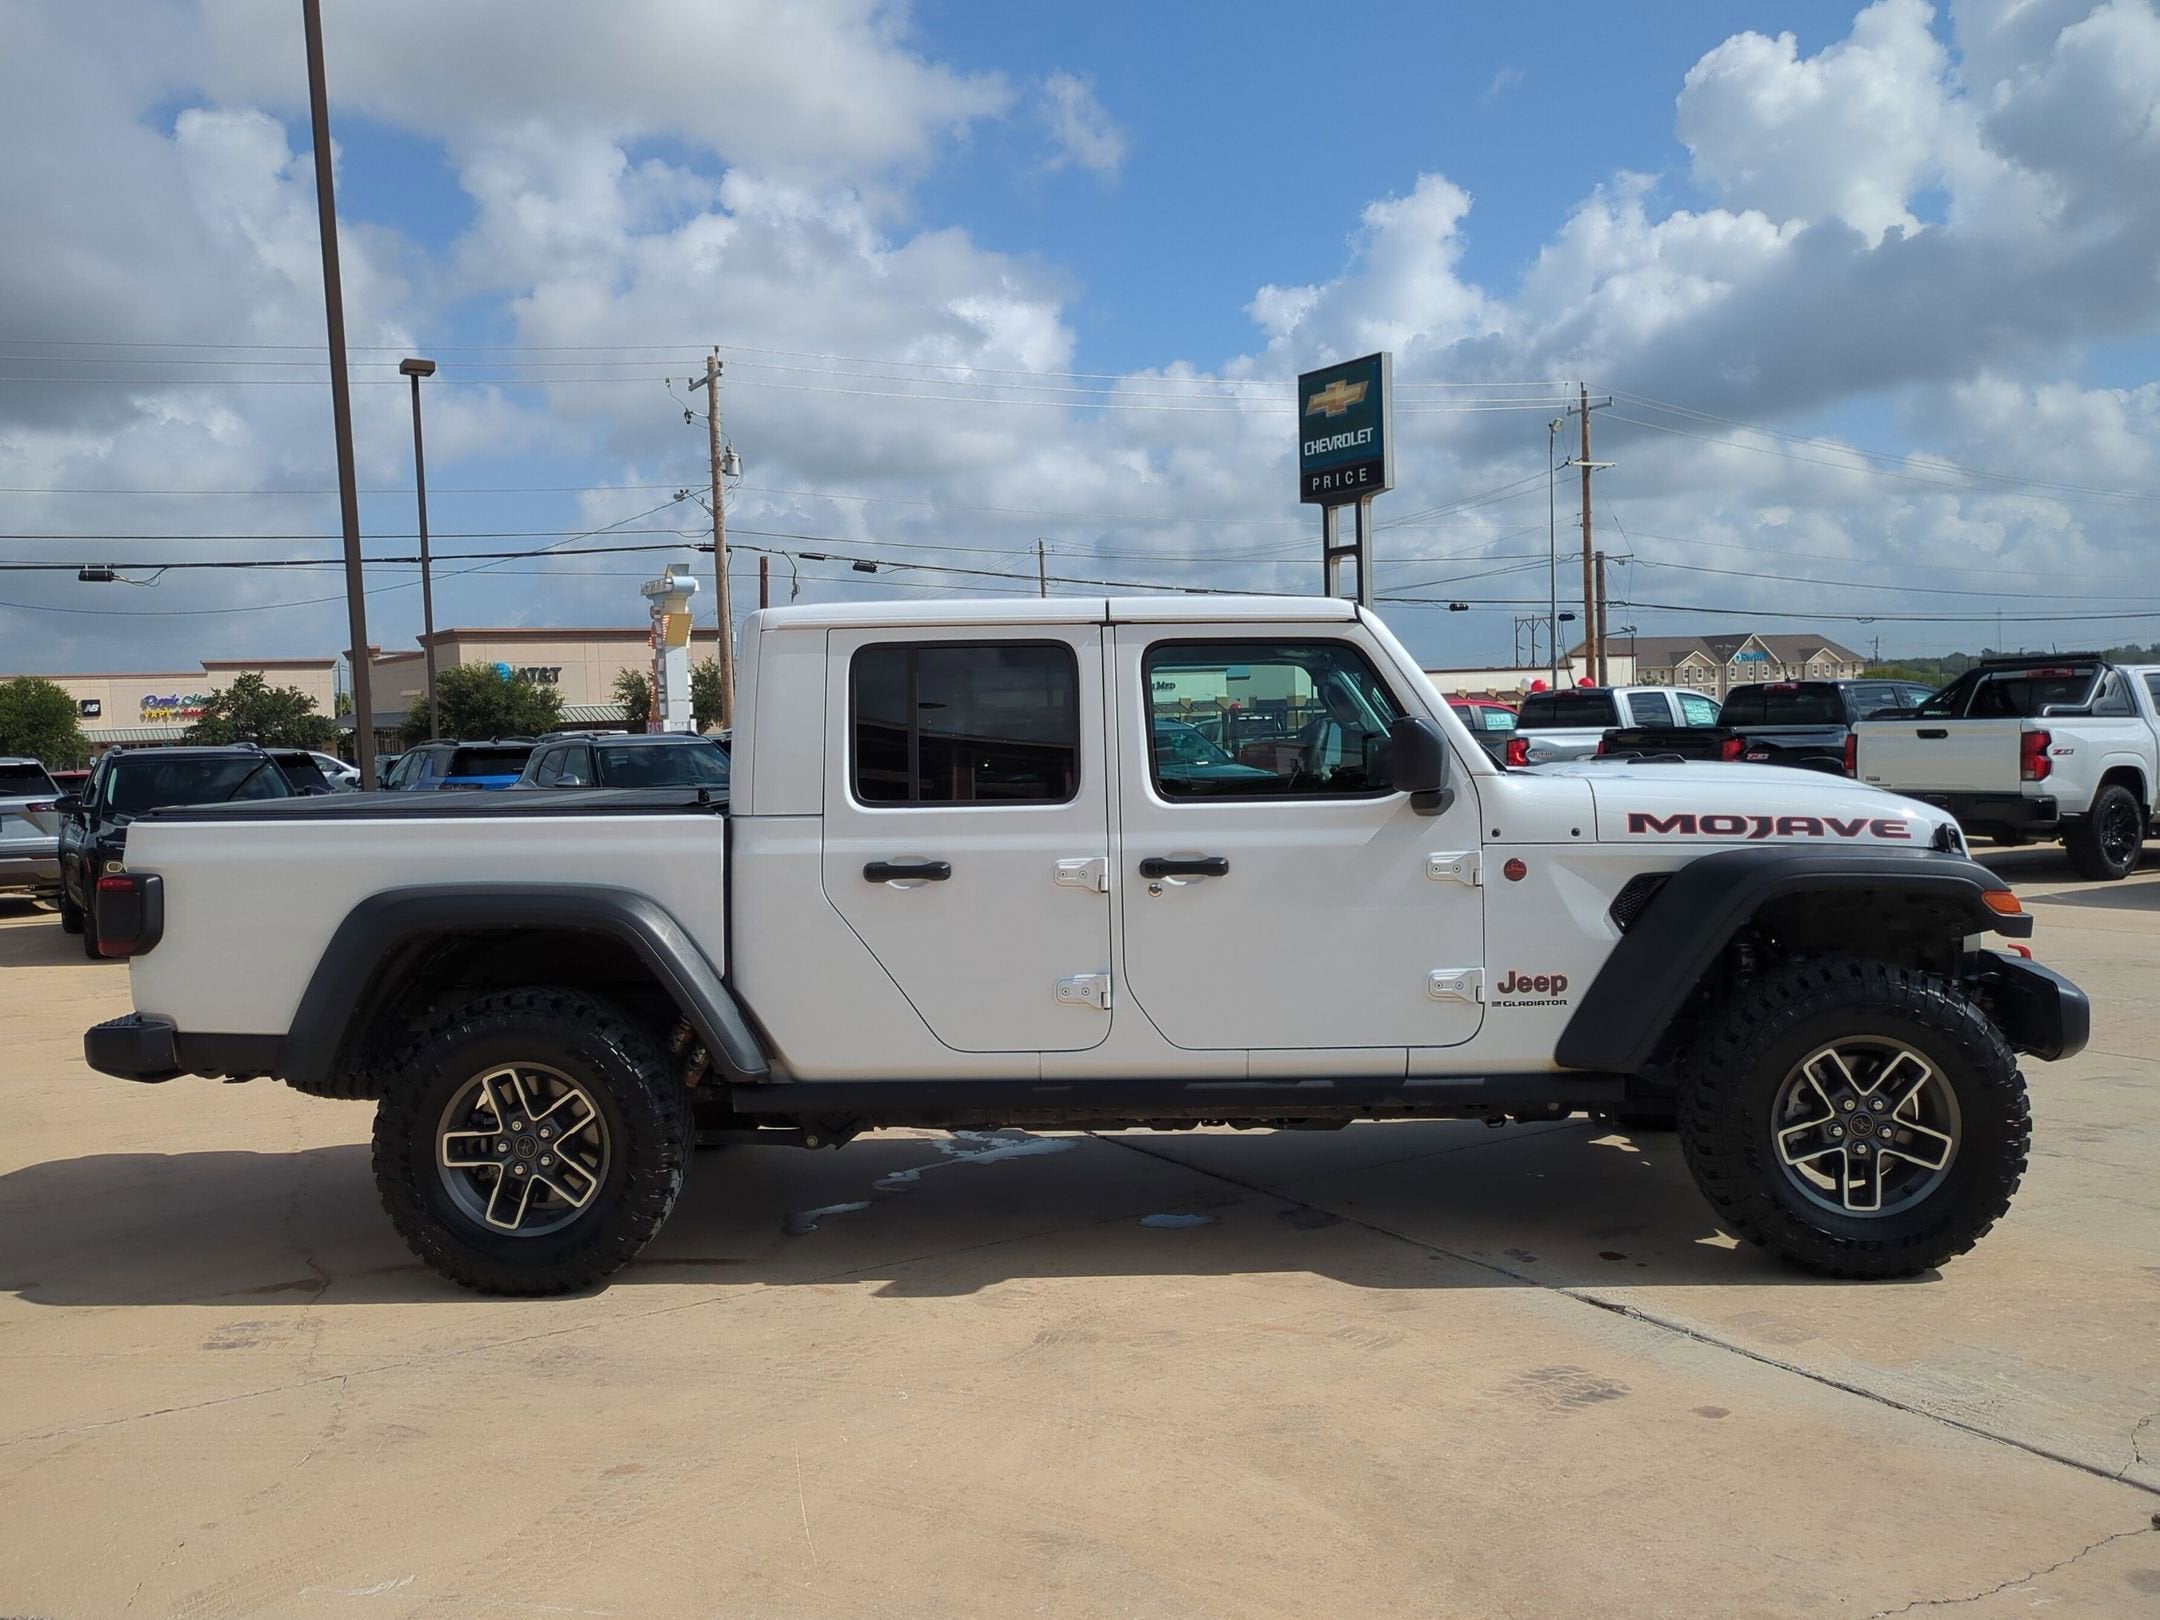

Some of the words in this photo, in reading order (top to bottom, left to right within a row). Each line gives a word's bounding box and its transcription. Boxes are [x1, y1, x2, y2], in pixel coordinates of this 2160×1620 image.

[1304, 427, 1373, 456] CHEVROLET
[1312, 468, 1368, 491] PRICE
[516, 667, 562, 683] AT&T
[1628, 812, 1912, 839] MOJAVE
[1497, 970, 1568, 996] Jeep
